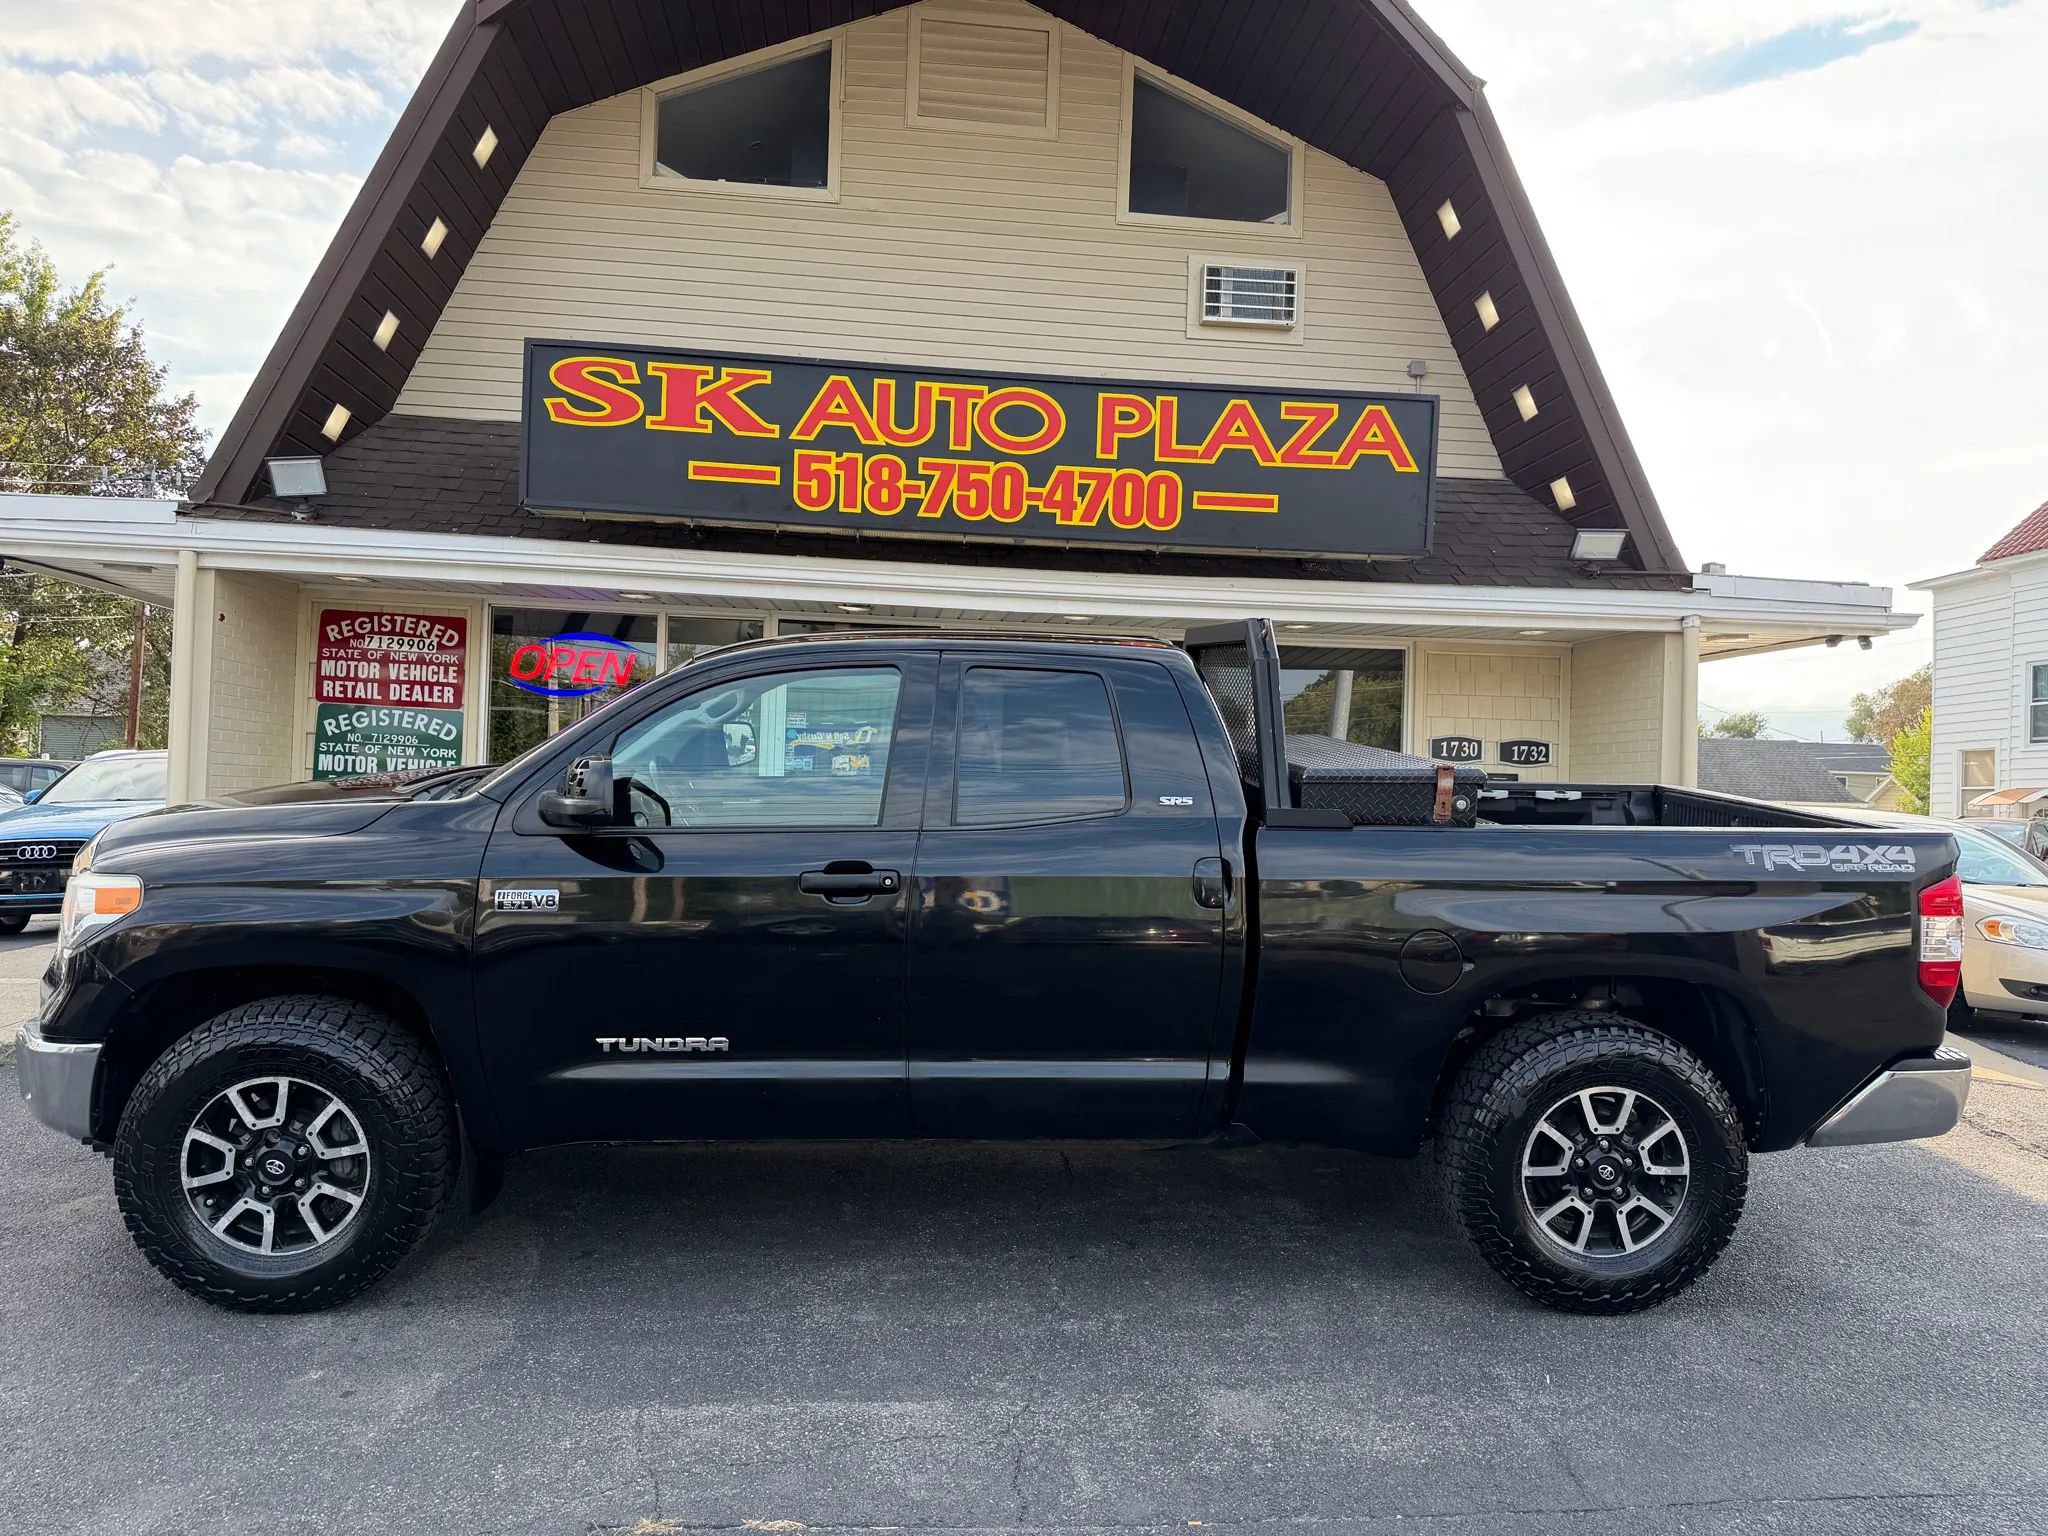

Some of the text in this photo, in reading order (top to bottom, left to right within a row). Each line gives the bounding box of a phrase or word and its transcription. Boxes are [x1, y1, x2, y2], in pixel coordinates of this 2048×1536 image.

[543, 356, 1420, 472] SK AUTO PLAZA
[793, 449, 1182, 531] 518-750-4700
[326, 615, 459, 647] REGISTERED
[366, 635, 435, 651] 7129906
[322, 648, 459, 664] STATE OF NEW YORK
[320, 660, 458, 683] MOTOR VEHICLE
[510, 644, 637, 686] OPEN
[323, 680, 454, 703] RETAIL DEALER
[323, 709, 457, 741] REGISTERED
[347, 733, 419, 745] NO. 7129906
[319, 742, 457, 758] STATE OF NEW YORK
[1440, 741, 1478, 757] 1730
[1512, 745, 1546, 761] 1732
[318, 754, 378, 773] MOTOR
[1159, 796, 1193, 805] SR5
[1730, 844, 1830, 871] TRD
[533, 894, 557, 908] V8
[595, 1037, 729, 1052] TUNDRA
